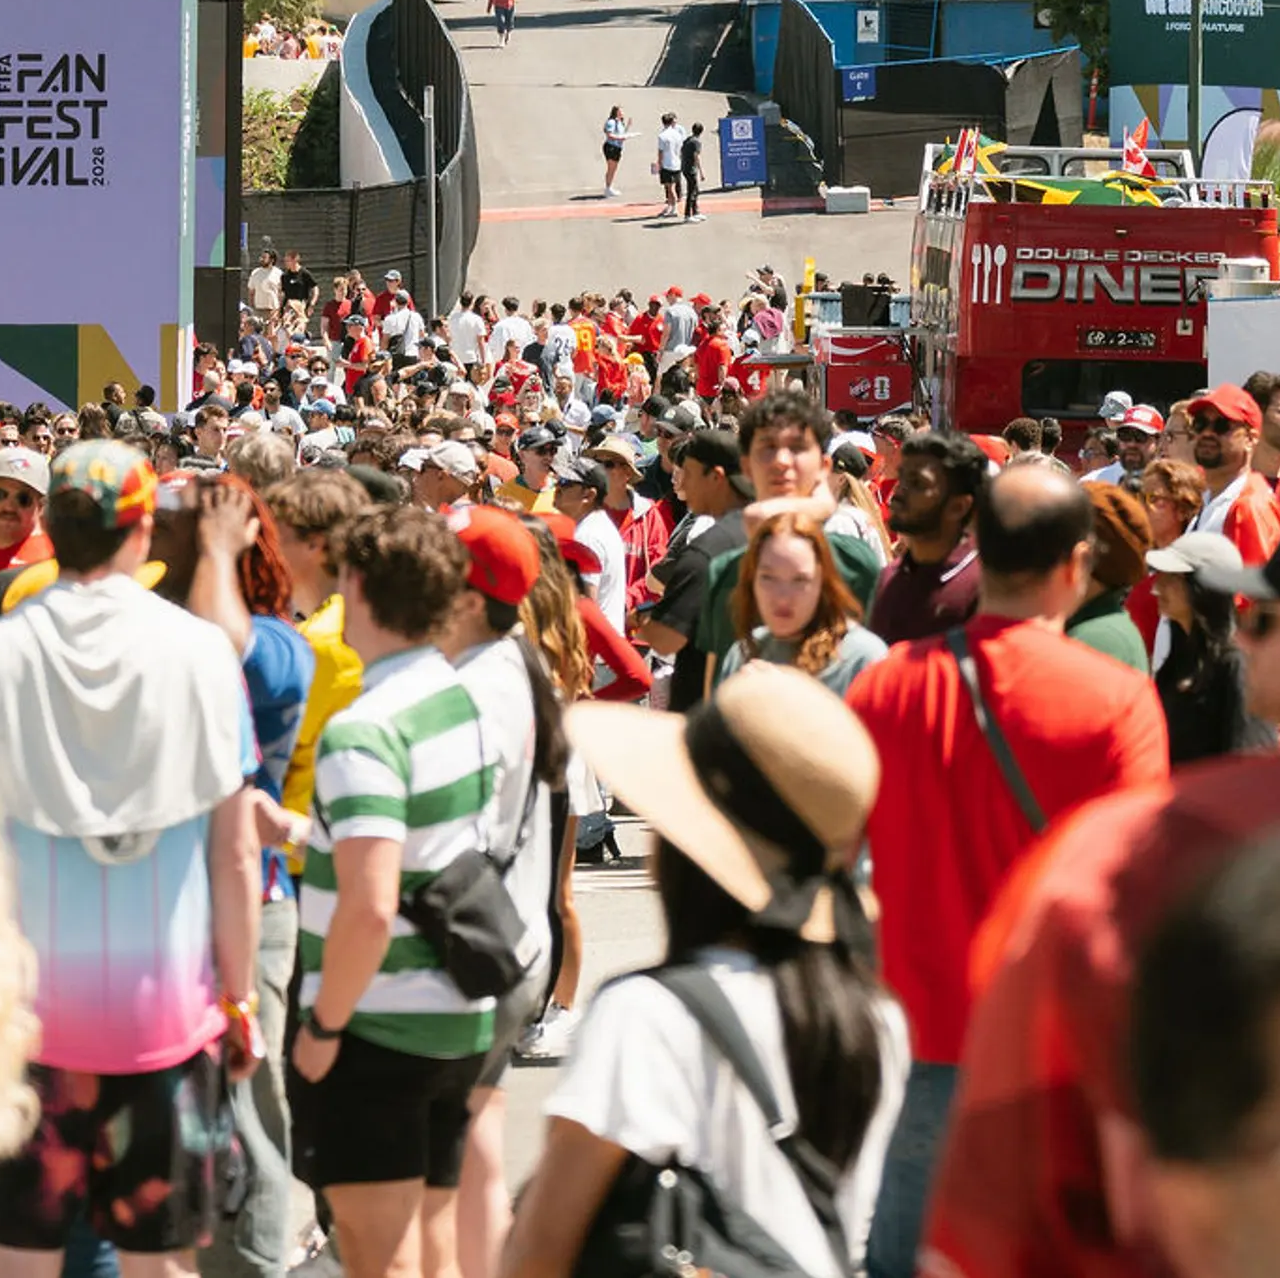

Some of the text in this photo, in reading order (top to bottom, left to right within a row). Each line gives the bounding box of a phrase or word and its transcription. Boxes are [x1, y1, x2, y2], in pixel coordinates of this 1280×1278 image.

[17, 53, 106, 93] FAN
[92, 146, 105, 186] 2026
[1016, 248, 1226, 264] DOUBLE DECKER
